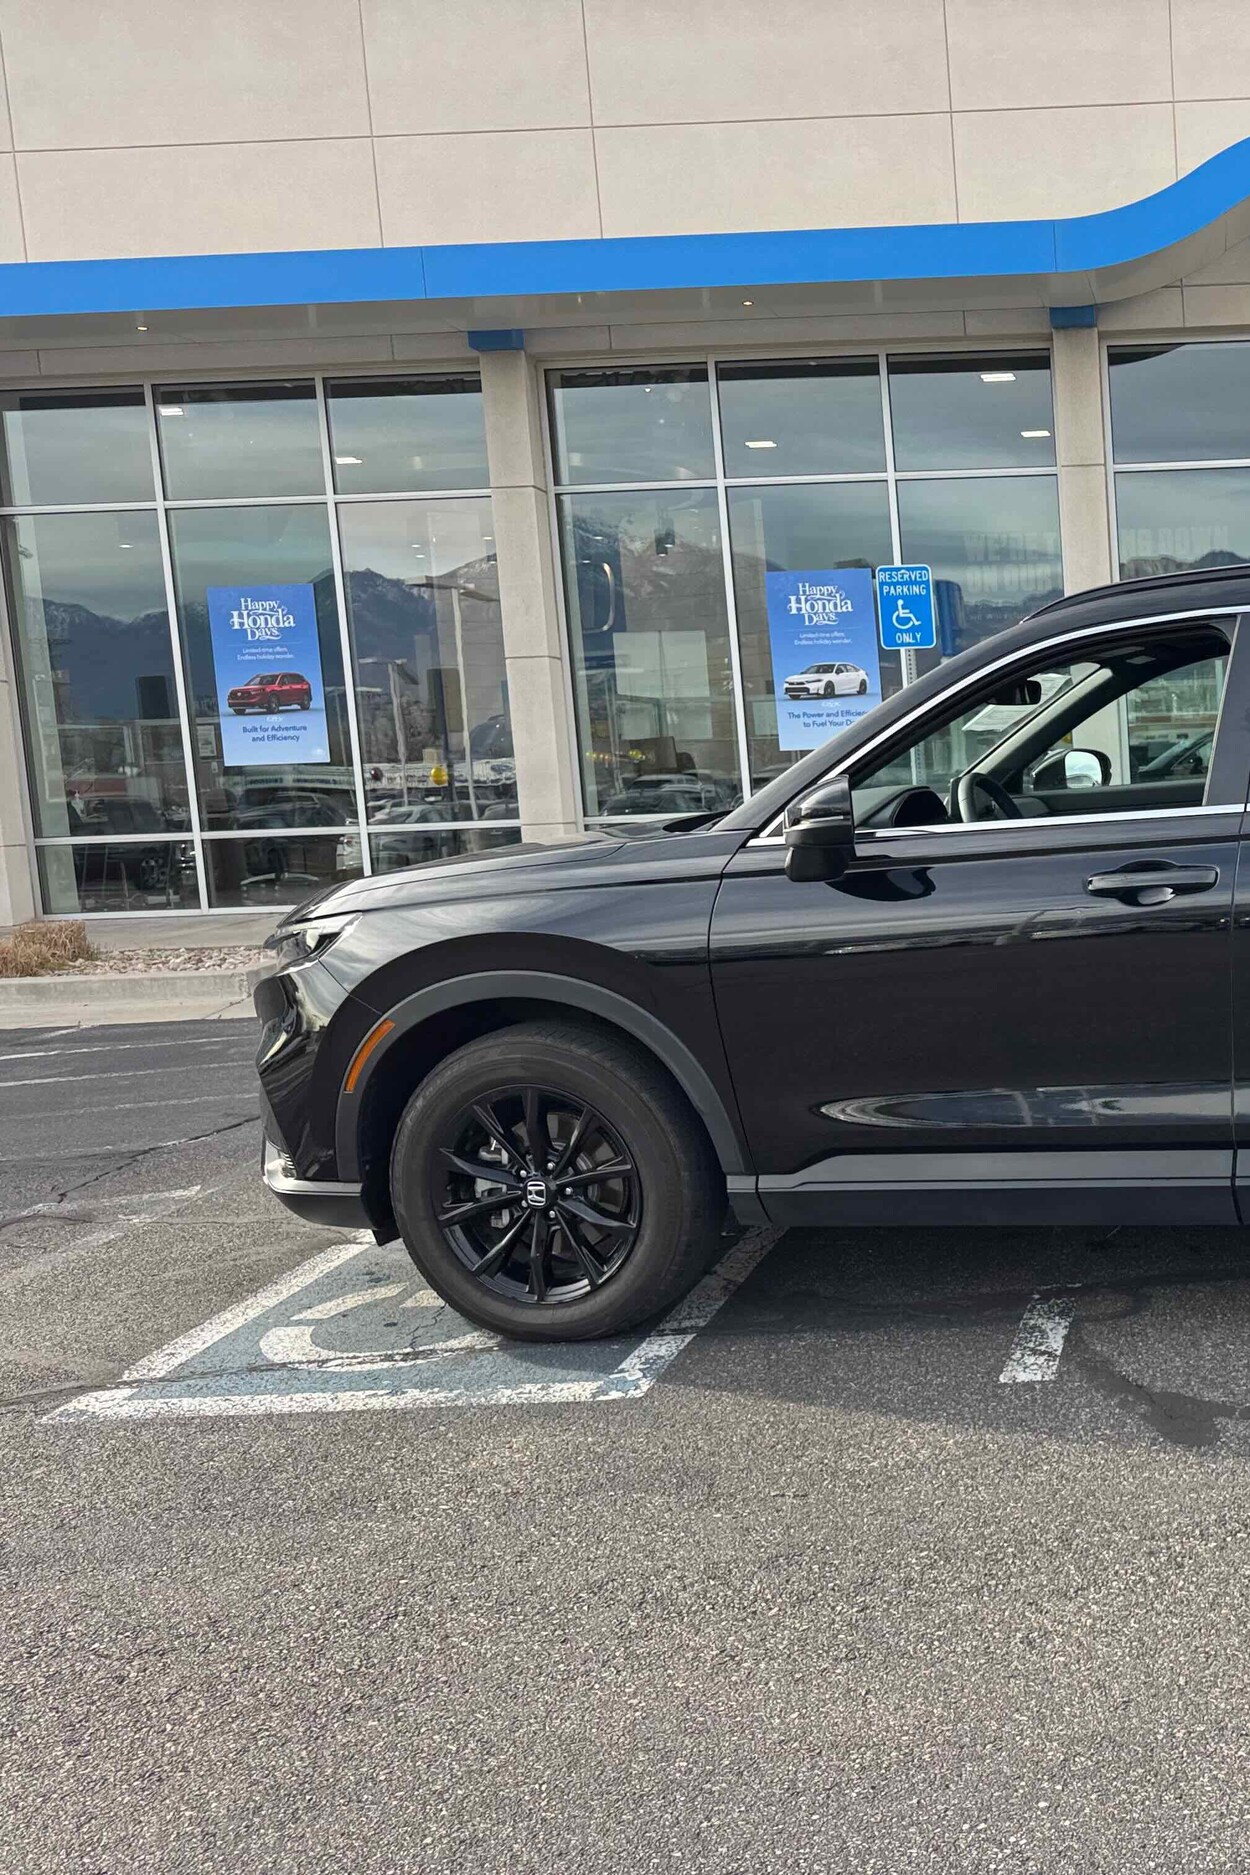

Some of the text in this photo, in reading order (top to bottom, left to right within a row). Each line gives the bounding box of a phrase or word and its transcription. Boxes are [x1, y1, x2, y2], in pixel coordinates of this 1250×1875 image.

[879, 570, 928, 582] RESERVED
[797, 583, 838, 600] Happy
[883, 584, 927, 596] PARKING
[240, 598, 280, 614] Happy
[787, 593, 853, 614] Honda
[230, 608, 296, 629] Honda
[804, 613, 839, 625] Days
[247, 627, 281, 641] Days
[895, 632, 921, 643] ONLY
[788, 711, 801, 719] The
[826, 710, 839, 718] and
[242, 725, 259, 733] Built
[260, 725, 270, 733] for
[812, 720, 827, 728] Fuel
[829, 719, 845, 727] Your
[252, 734, 300, 743] and Efficiency
